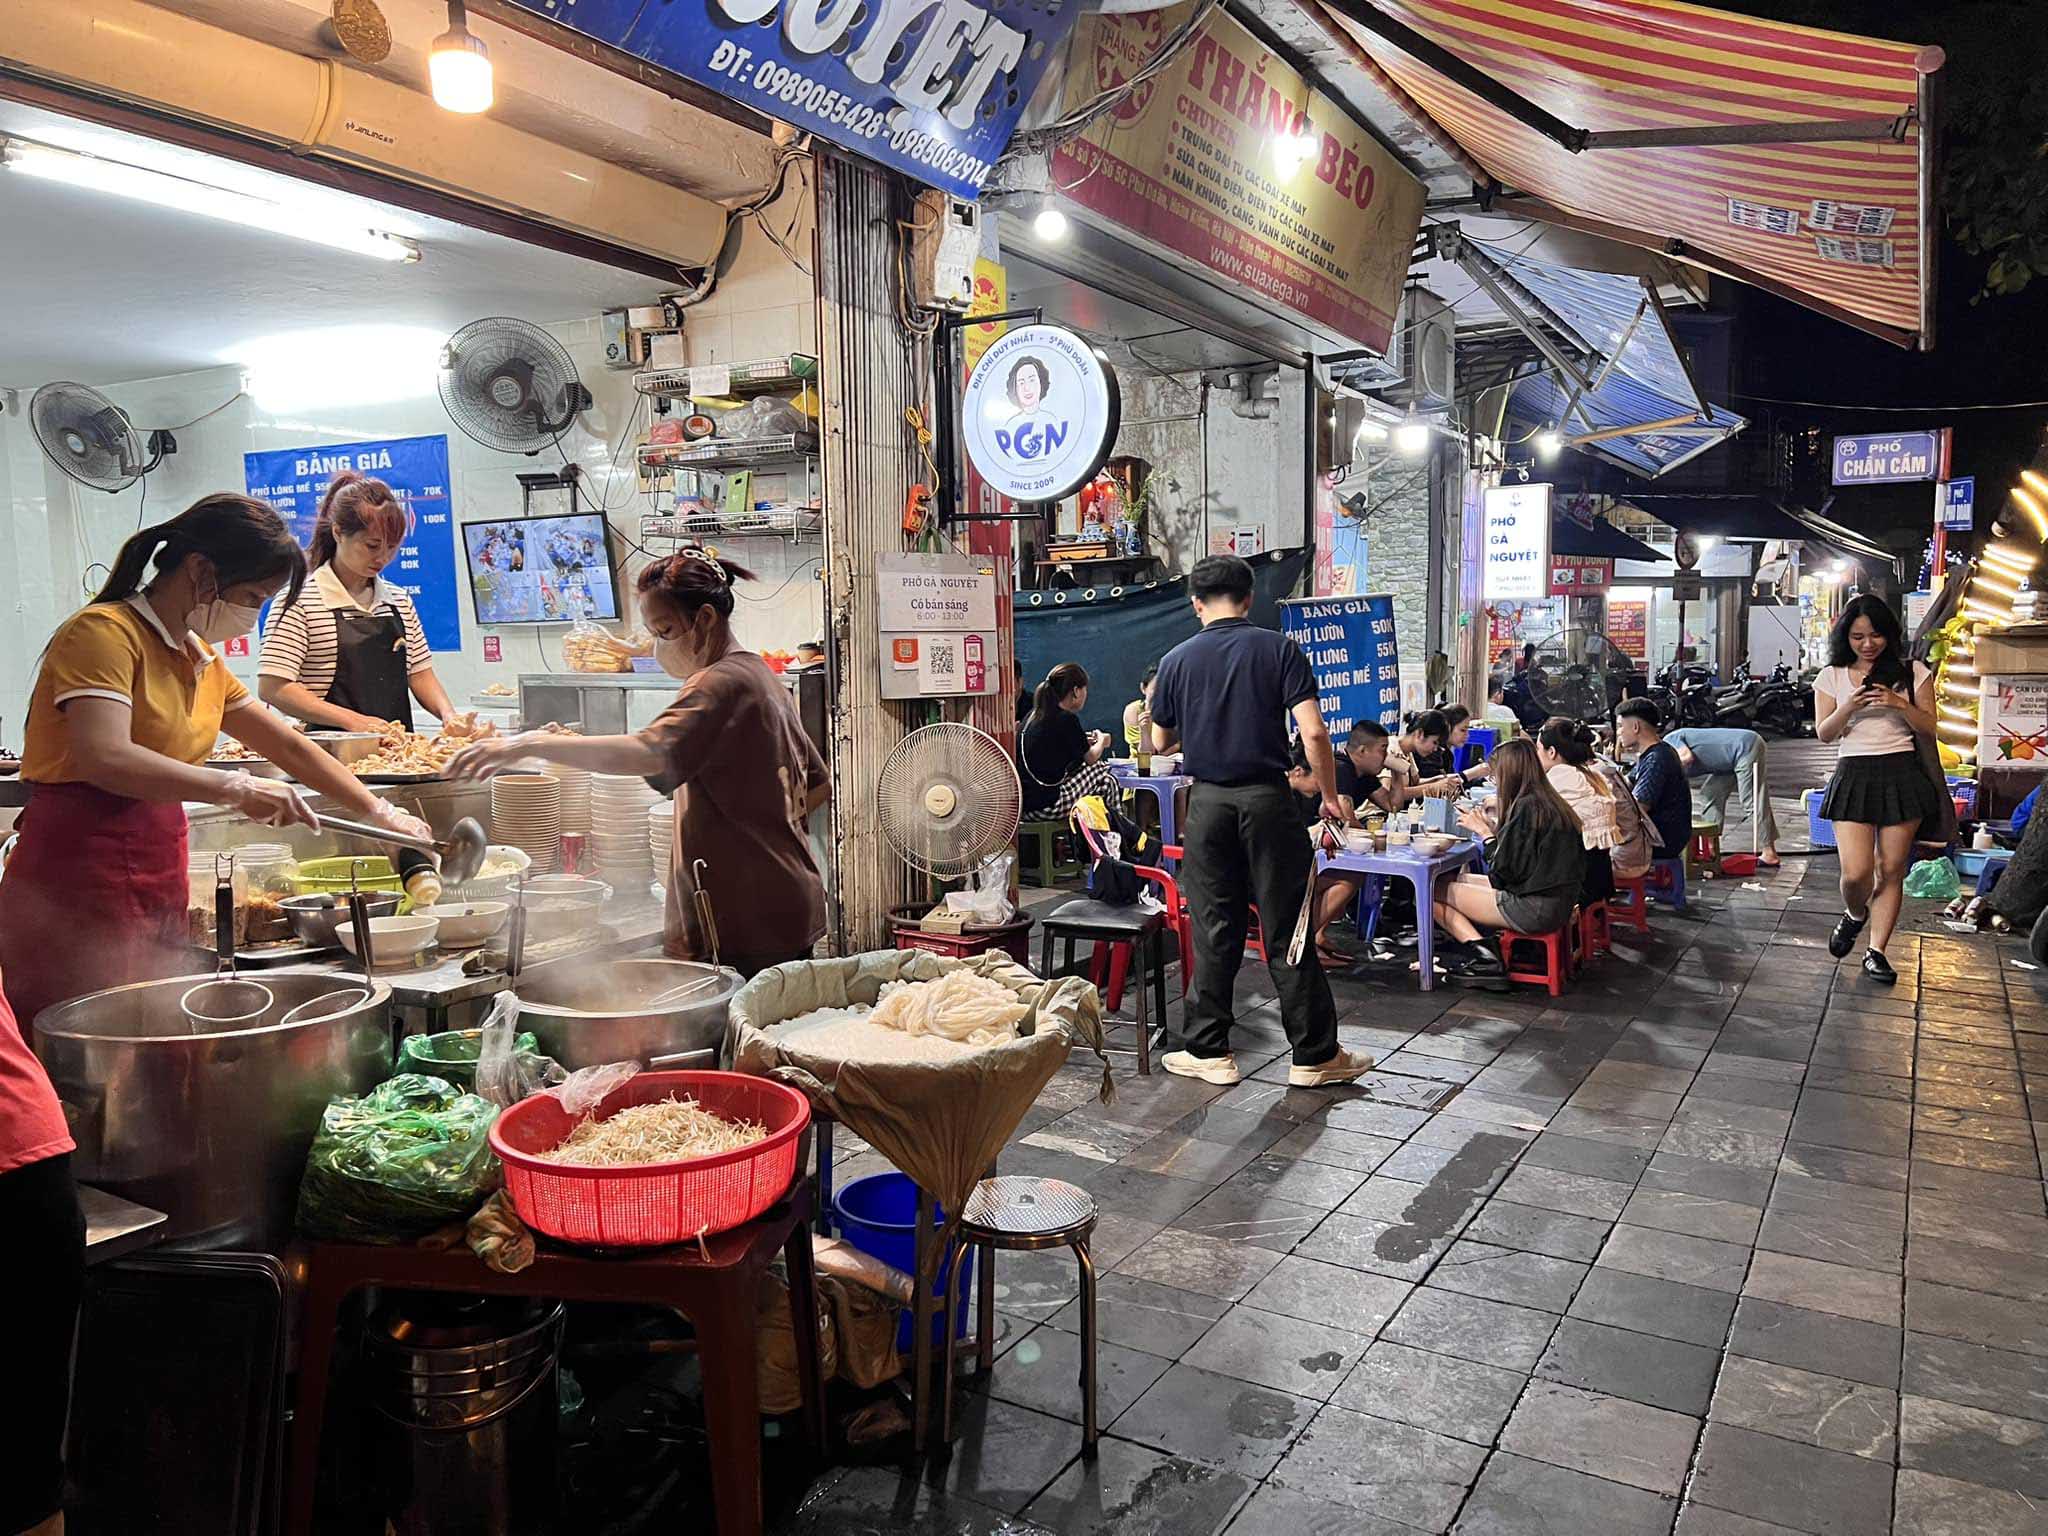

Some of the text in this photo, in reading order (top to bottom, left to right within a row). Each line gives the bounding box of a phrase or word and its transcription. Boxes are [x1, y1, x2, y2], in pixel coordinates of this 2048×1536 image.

[1868, 438, 1902, 454] PHỐ
[295, 448, 393, 476] BẢNG GIÁ
[1842, 455, 1887, 477] CHÂN
[423, 486, 443, 496] 70K
[400, 546, 419, 557] 70K
[911, 598, 969, 612] Có bán sáng
[1371, 618, 1393, 634] 50K
[1376, 641, 1395, 657] 55K
[1378, 664, 1397, 680] 55K
[1379, 687, 1398, 704] 60K
